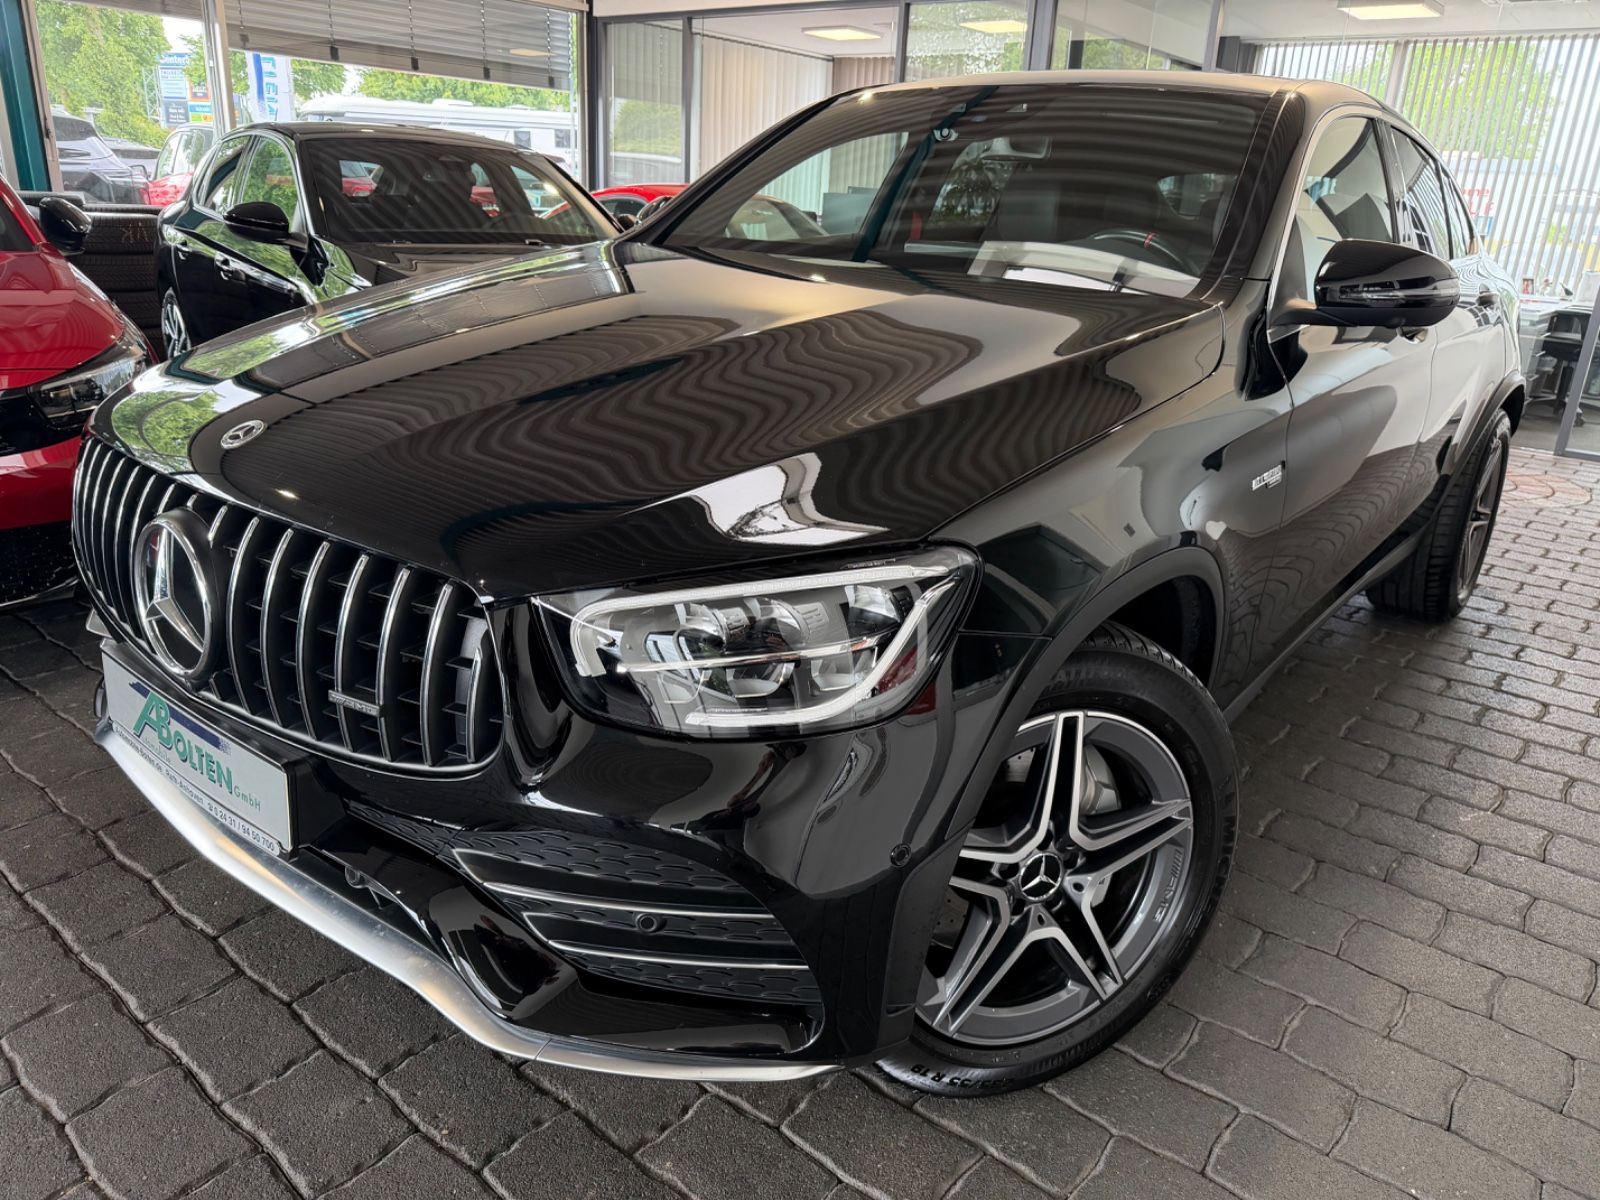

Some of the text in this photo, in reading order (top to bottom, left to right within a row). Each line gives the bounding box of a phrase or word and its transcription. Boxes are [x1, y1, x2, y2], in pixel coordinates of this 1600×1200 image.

[233, 785, 261, 813] GmbH
[910, 1063, 931, 1077] 19
[931, 1071, 946, 1083] R
